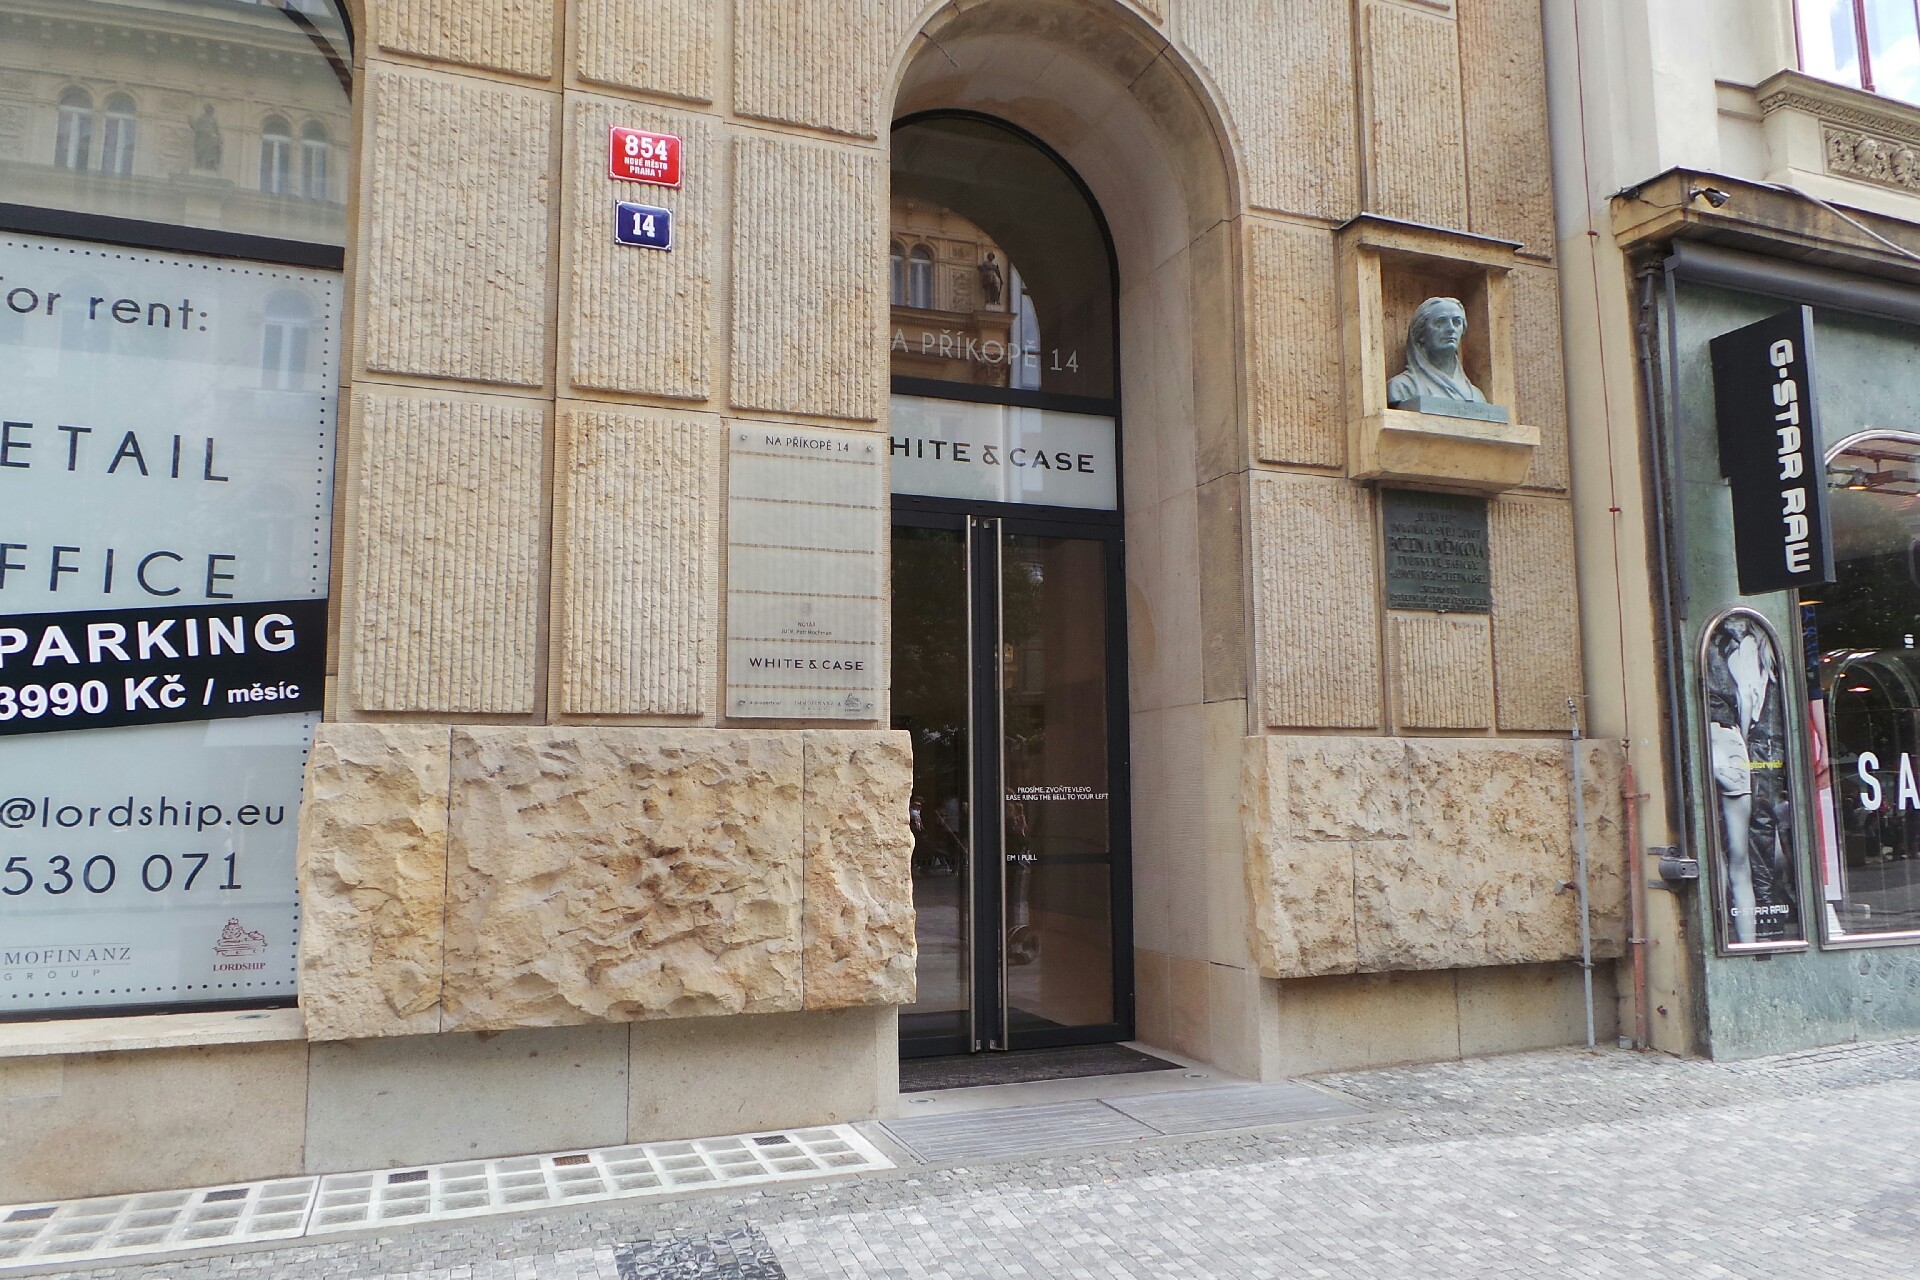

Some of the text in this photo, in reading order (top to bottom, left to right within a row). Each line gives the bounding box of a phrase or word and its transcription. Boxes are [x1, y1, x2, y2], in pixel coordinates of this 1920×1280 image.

[625, 135, 668, 160] 854
[624, 157, 668, 170] NOVÉ MĚSTO
[630, 165, 655, 176] PRAHA
[633, 213, 655, 237] 14
[89, 297, 208, 330] rent:
[921, 329, 1037, 368] PŘÍKOPĚ
[1050, 348, 1079, 373] 14
[765, 436, 849, 452] NA PŘÍKOPĚ 14
[983, 444, 1000, 465] &
[1009, 448, 1095, 474] CASE
[1782, 488, 1810, 573] RAW
[0, 613, 296, 668] PARKING
[750, 657, 864, 670] WHITE & CASE
[0, 674, 300, 721] 3990 Kč / měsíc
[1, 852, 243, 895] 530 071
[1770, 904, 1790, 914] RAW
[4, 969, 100, 981] GROUP
[213, 963, 266, 971] LORDSHIP
